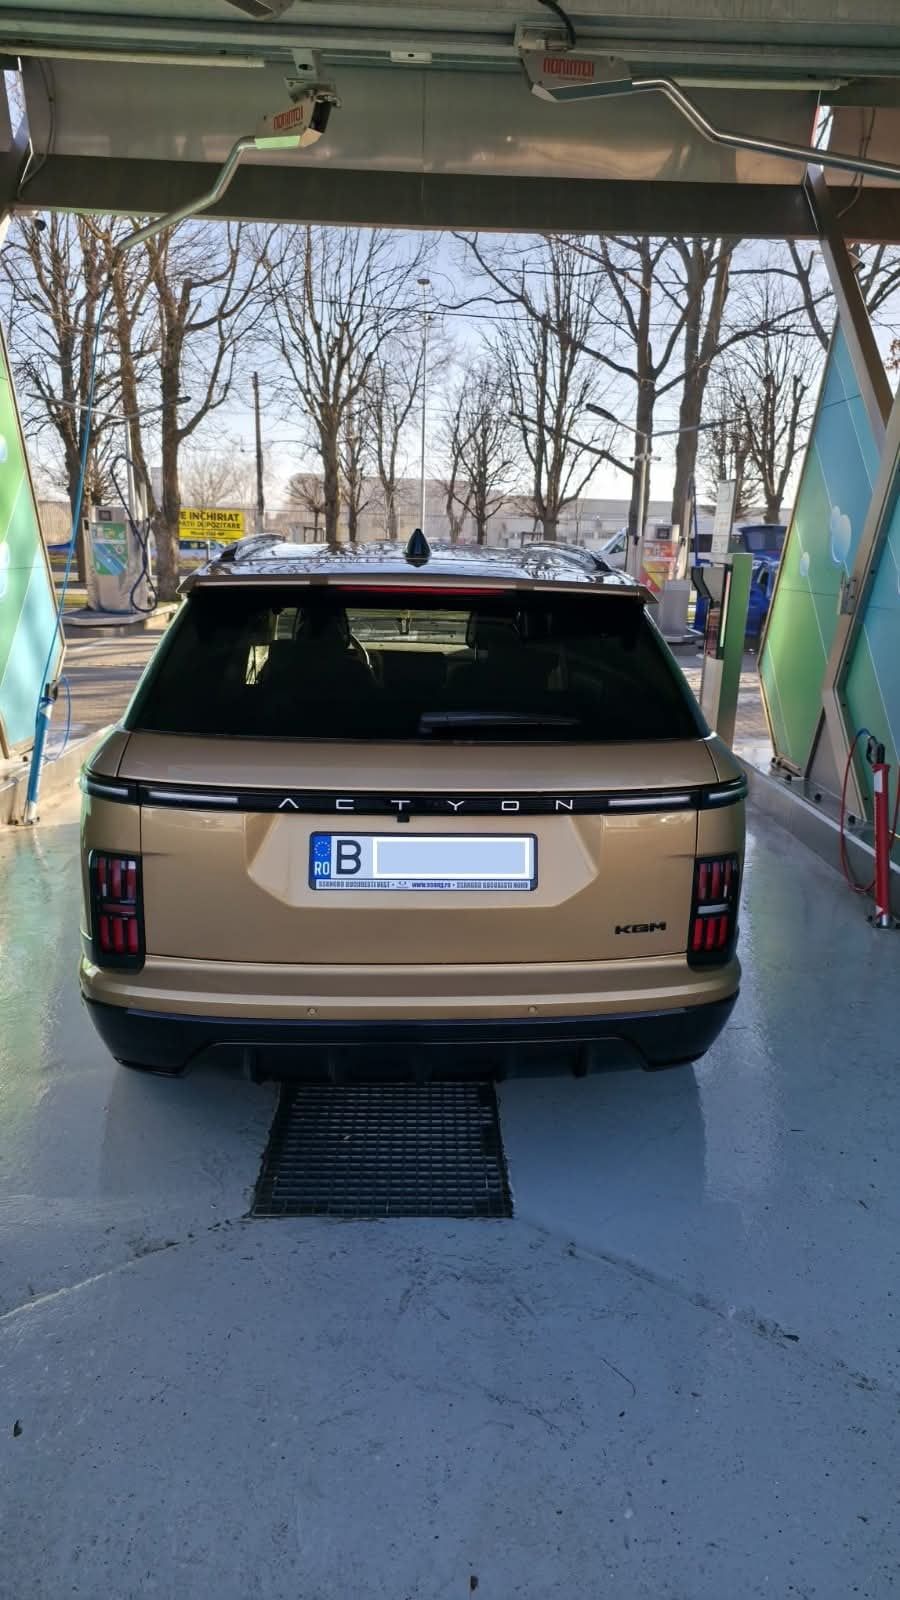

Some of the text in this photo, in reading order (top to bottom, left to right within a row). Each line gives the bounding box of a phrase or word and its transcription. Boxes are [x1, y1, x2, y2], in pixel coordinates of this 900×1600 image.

[189, 511, 240, 521] INCHIRIAT
[277, 797, 574, 811] ACTYON
[336, 839, 362, 875] B
[314, 861, 330, 876] RO
[615, 921, 667, 935] KGM
